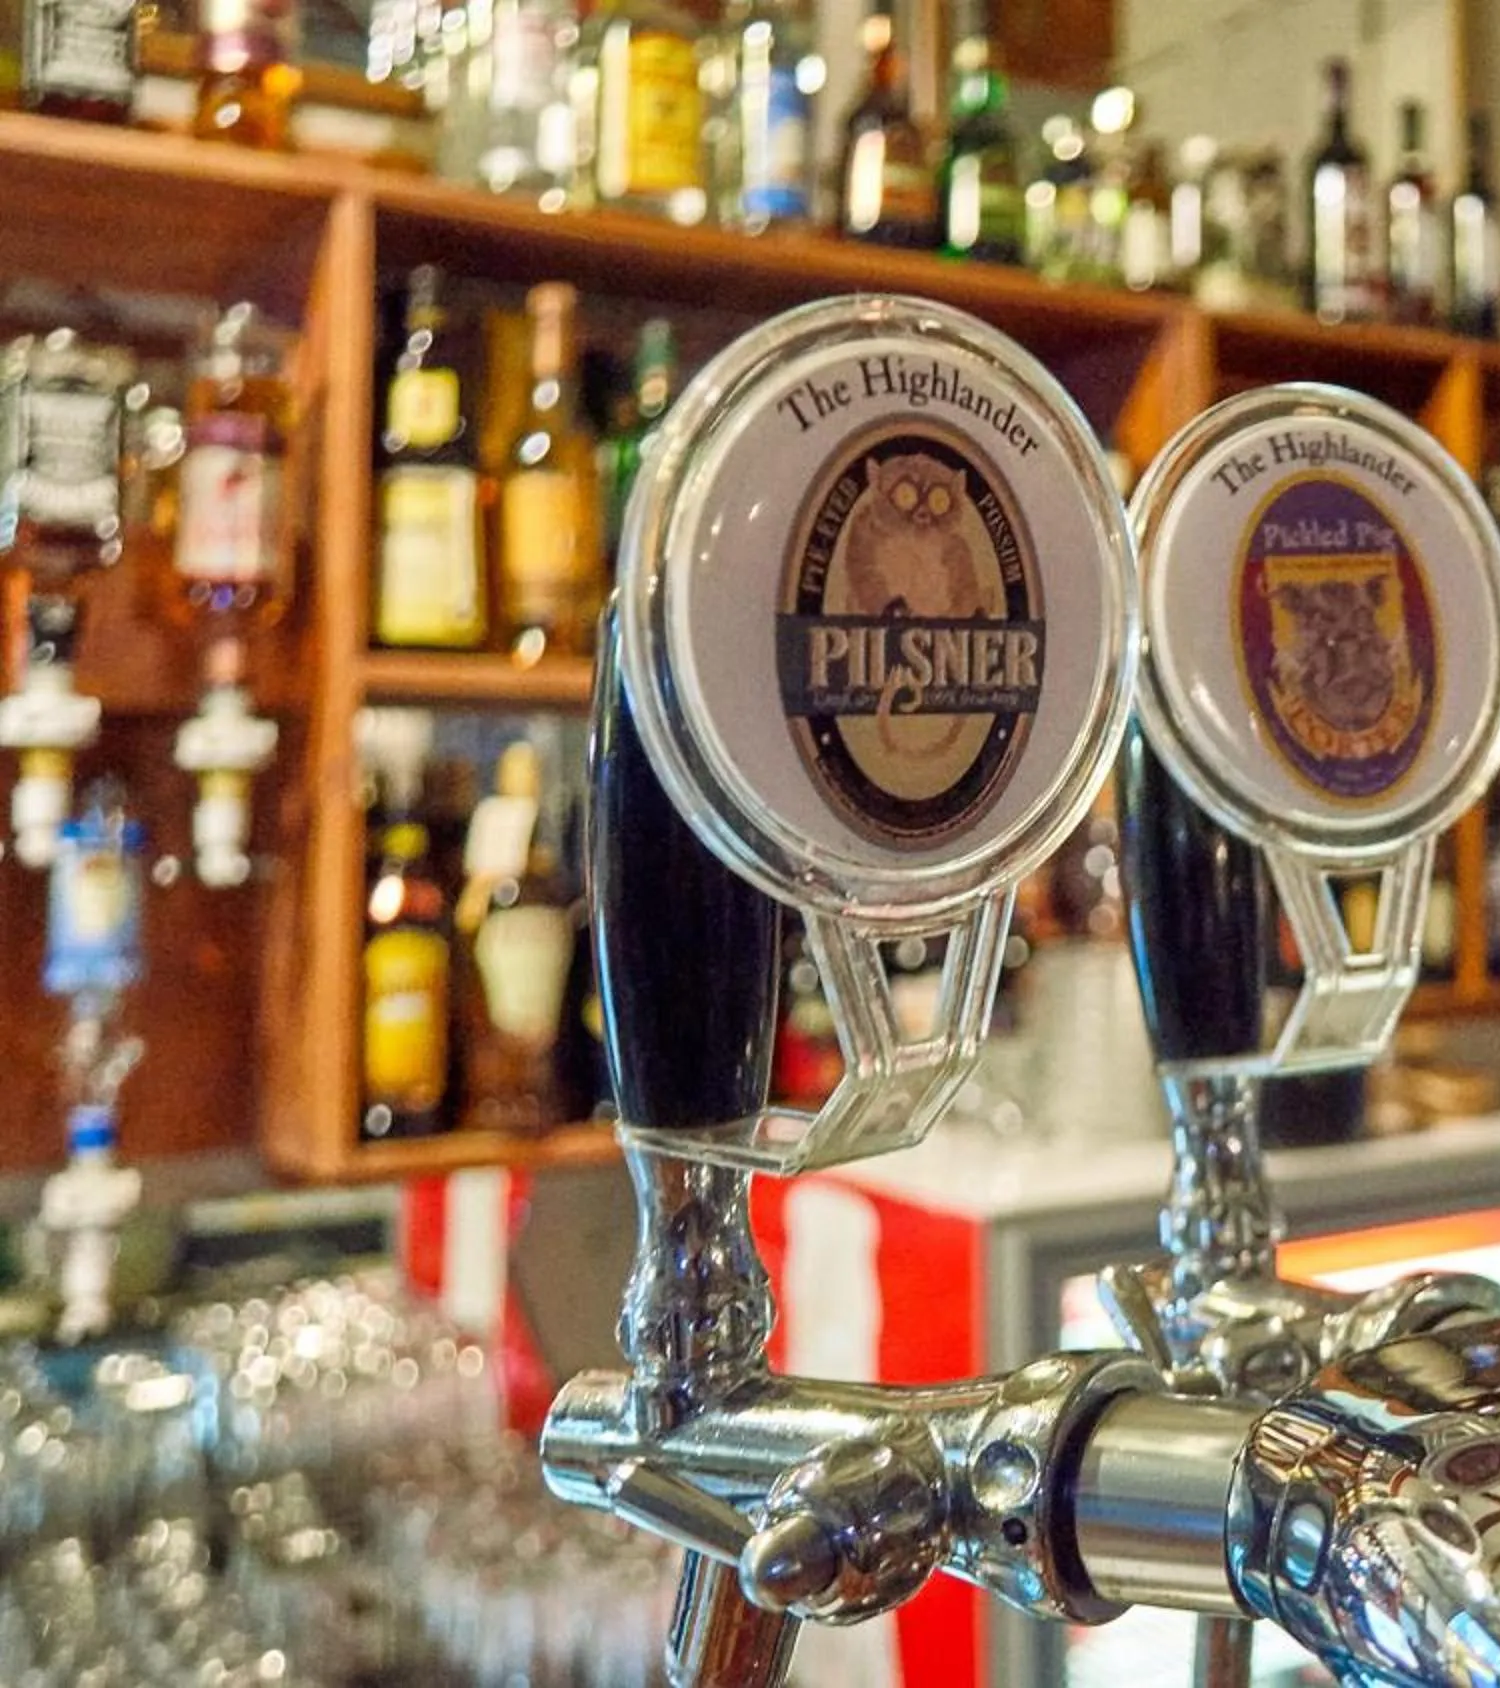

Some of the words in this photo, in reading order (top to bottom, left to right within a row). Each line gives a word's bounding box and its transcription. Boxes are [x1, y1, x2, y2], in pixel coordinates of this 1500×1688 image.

[777, 380, 850, 432] The
[858, 354, 1040, 456] Highlander
[1211, 453, 1267, 496] The
[1268, 431, 1418, 496] Highlander
[1263, 519, 1349, 549] Pickled
[1355, 520, 1397, 551] Pig
[808, 625, 1039, 688] PILSNER
